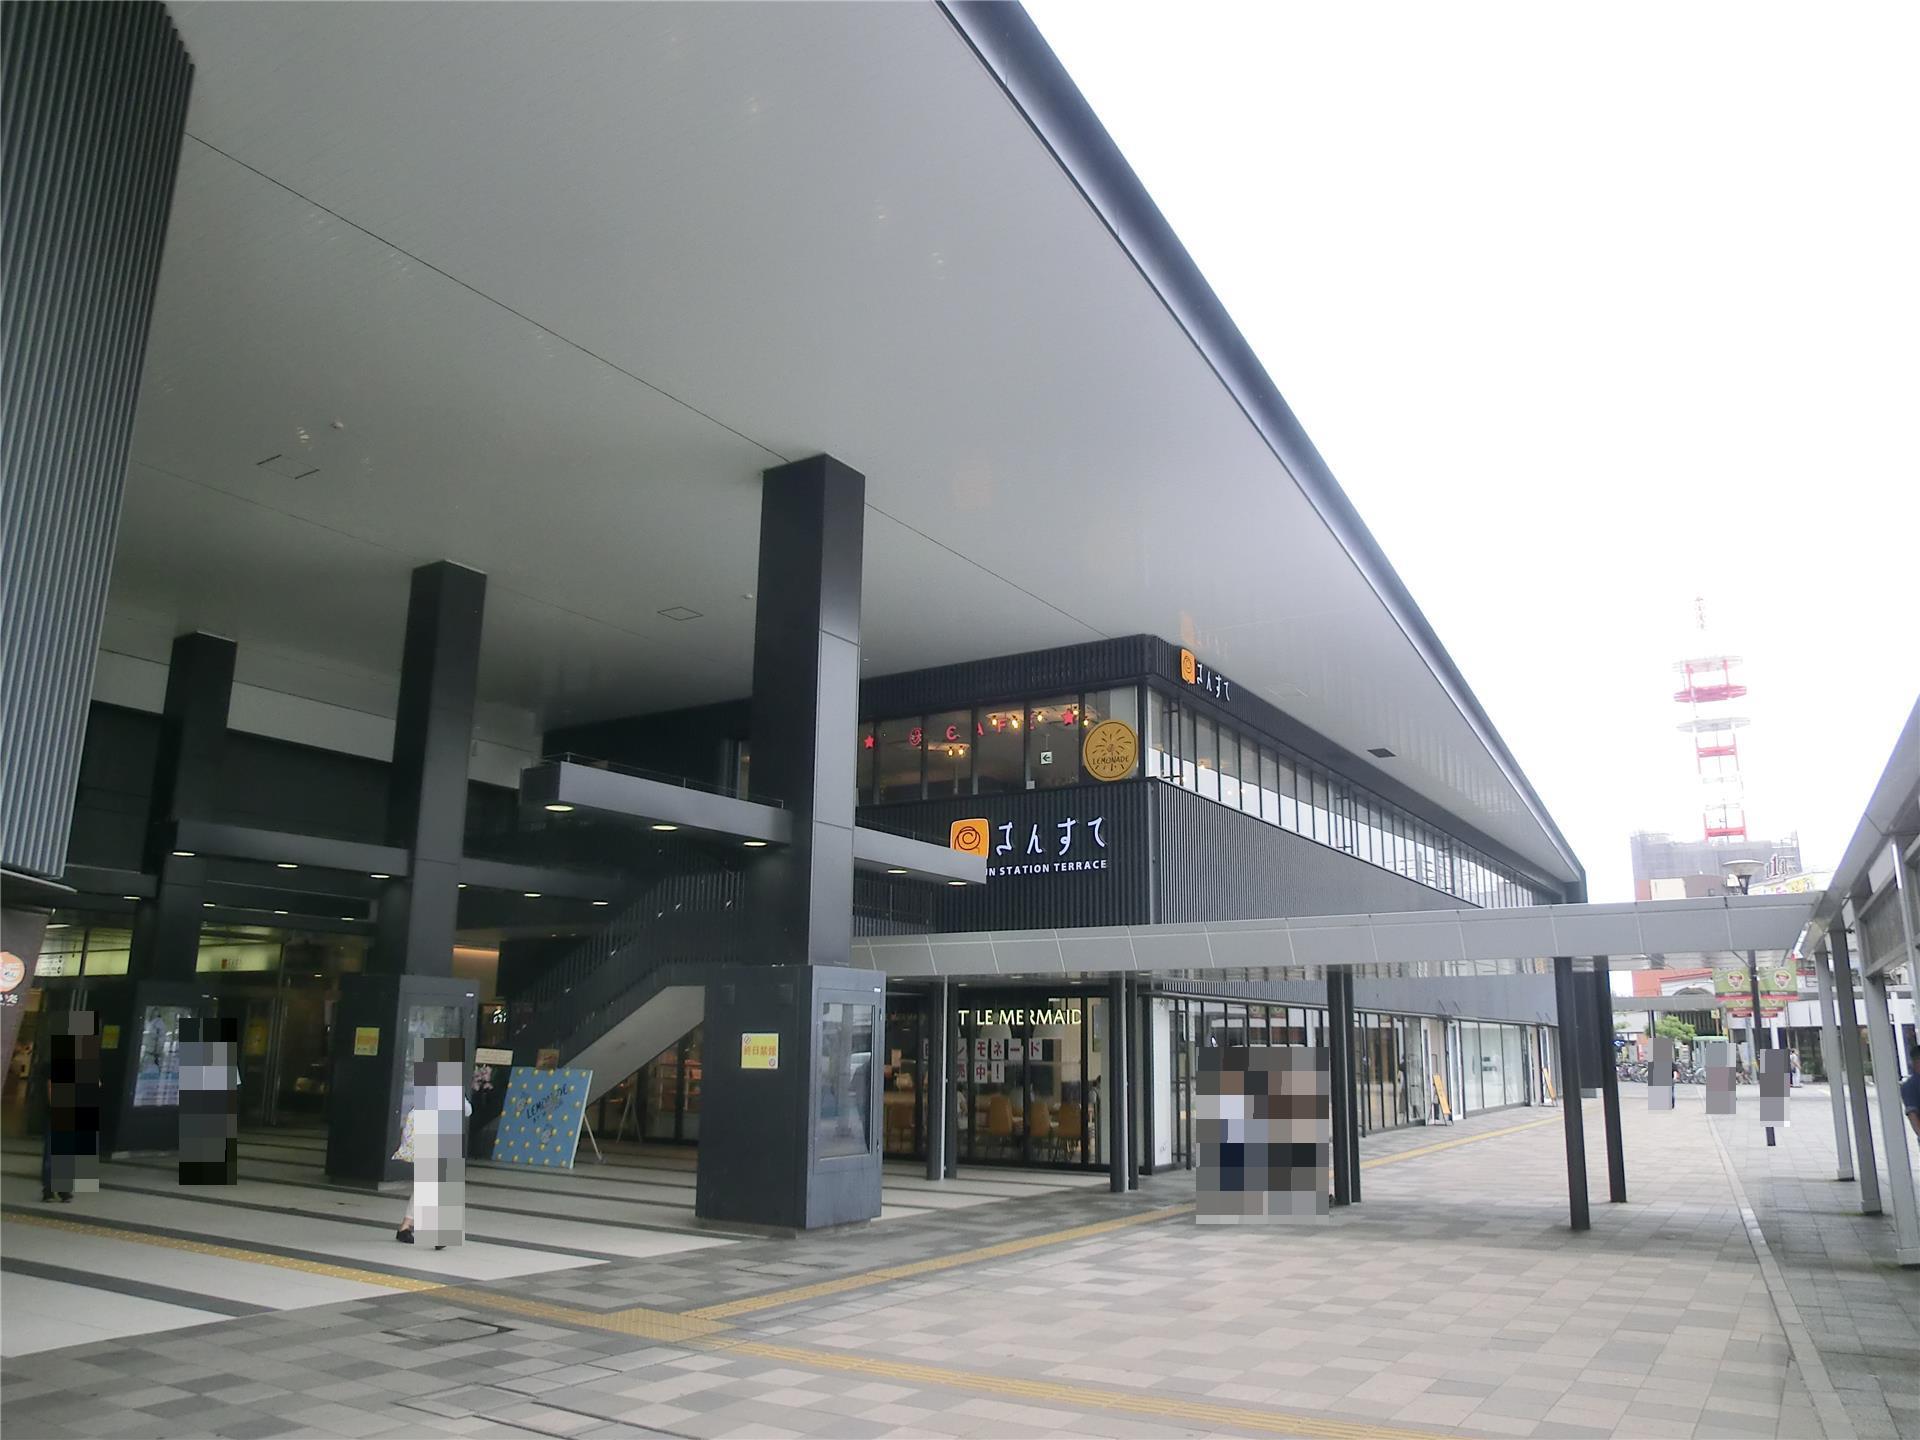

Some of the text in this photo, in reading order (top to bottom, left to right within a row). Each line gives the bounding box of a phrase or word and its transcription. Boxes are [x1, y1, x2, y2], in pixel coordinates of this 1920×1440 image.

[1196, 663, 1230, 701] さんすて
[996, 817, 1106, 856] さんすて
[999, 863, 1050, 876] STATION
[1053, 859, 1107, 872] TERRACE
